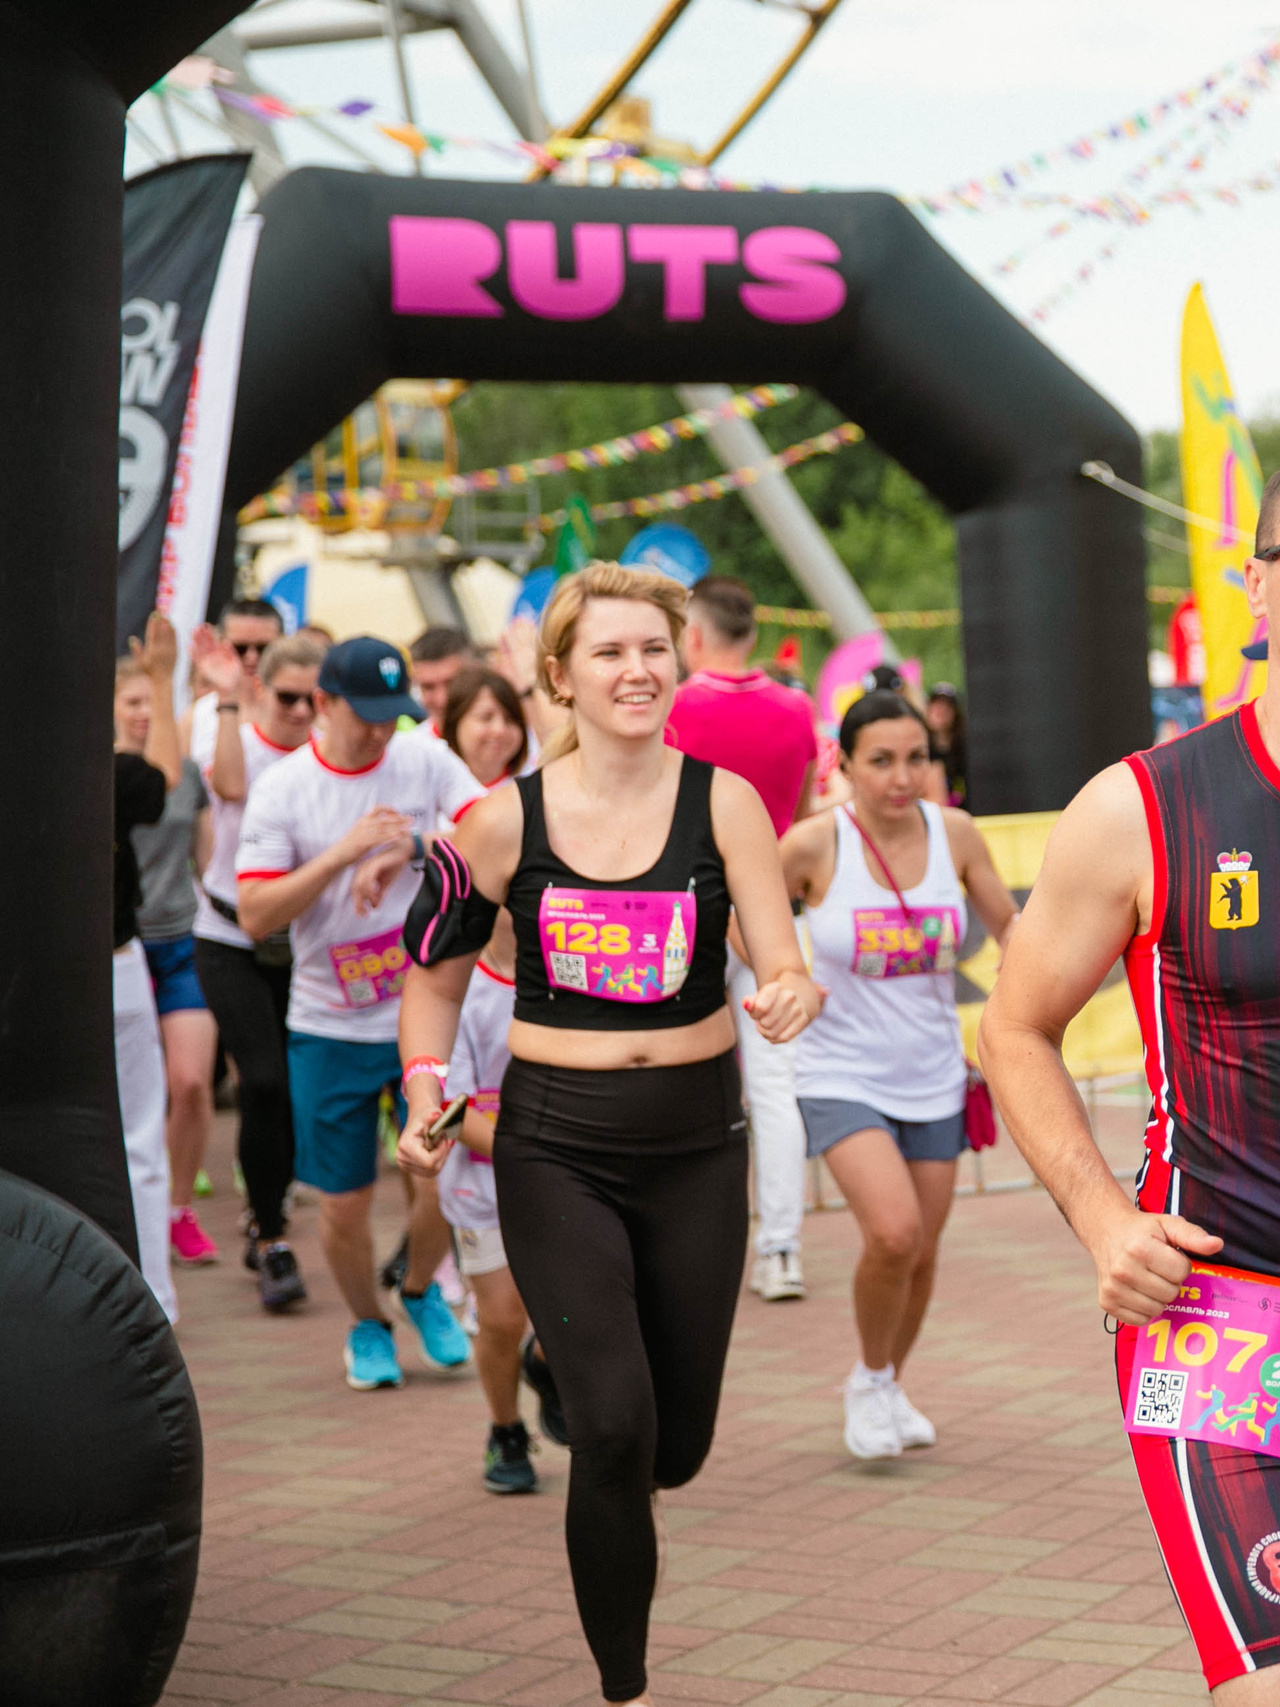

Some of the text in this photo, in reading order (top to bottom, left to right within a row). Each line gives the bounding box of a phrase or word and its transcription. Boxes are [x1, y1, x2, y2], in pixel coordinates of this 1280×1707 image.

[389, 214, 848, 325] RUTS
[546, 921, 631, 955] 128
[1164, 1304, 1230, 1319] ОСЛАВЛЬ 2023
[1146, 1318, 1268, 1373] 107
